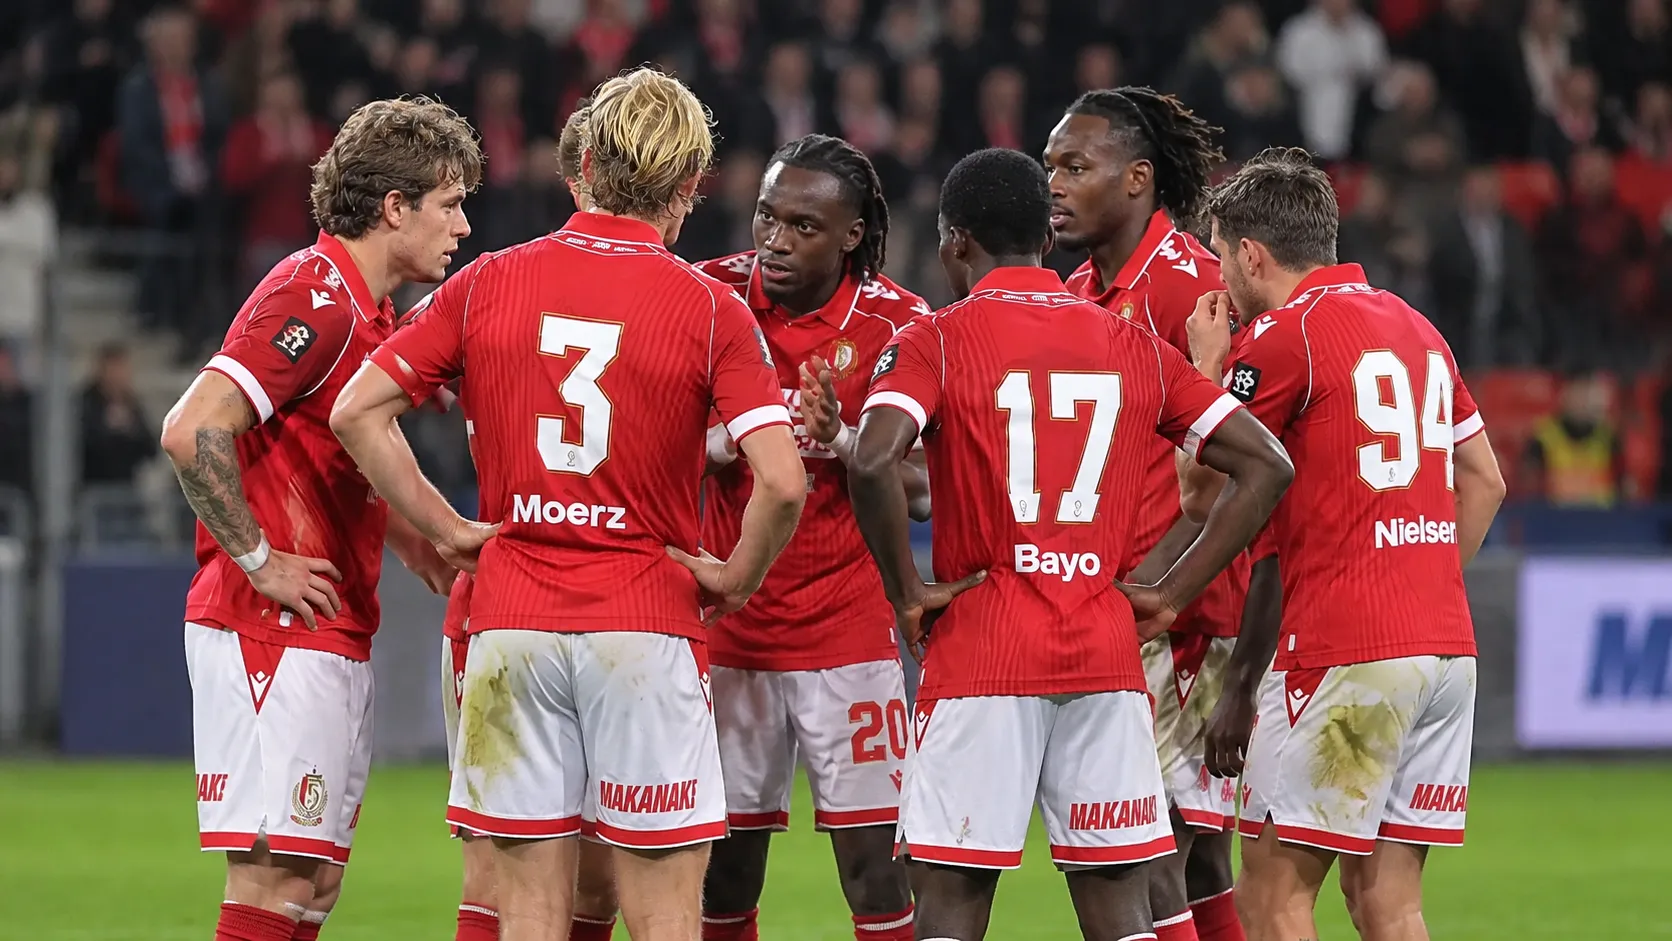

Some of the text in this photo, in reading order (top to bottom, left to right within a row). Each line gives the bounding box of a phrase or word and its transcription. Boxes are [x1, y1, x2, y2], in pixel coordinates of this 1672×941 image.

[536, 314, 623, 477] 3
[1352, 349, 1455, 491] 94
[995, 370, 1122, 524] 17
[512, 494, 626, 530] Moerz
[1014, 543, 1101, 582] Bayo
[848, 698, 909, 765] 20
[1409, 783, 1467, 812] MAKA
